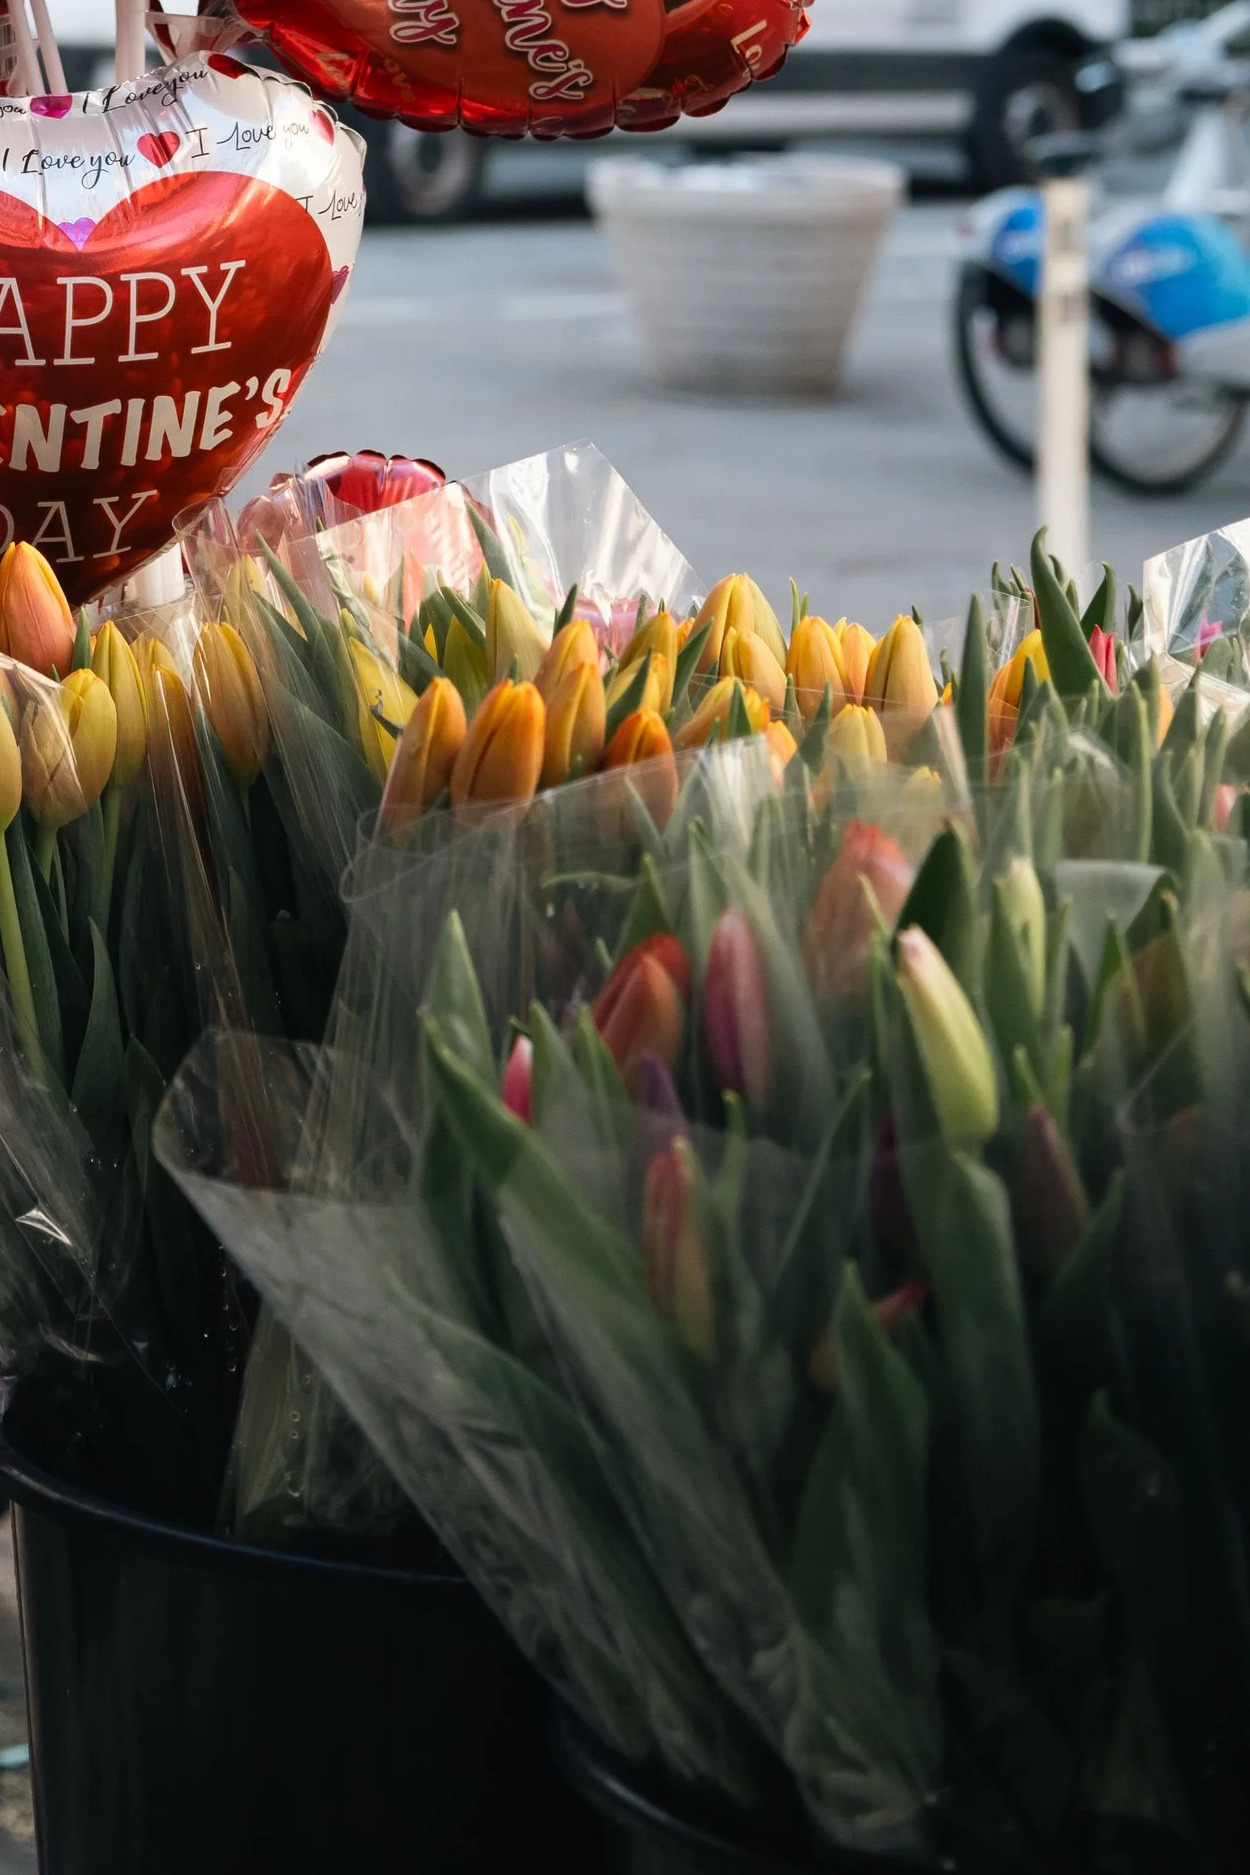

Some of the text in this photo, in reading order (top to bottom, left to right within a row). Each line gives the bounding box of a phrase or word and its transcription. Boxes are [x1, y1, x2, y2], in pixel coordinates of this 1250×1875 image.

[102, 85, 162, 114] Love
[158, 68, 209, 106] you
[2, 151, 9, 172] I
[20, 148, 84, 176] Love
[81, 151, 135, 190] you
[185, 127, 209, 159] I
[216, 121, 277, 151] Love
[283, 123, 310, 148] you
[318, 190, 358, 221] Love
